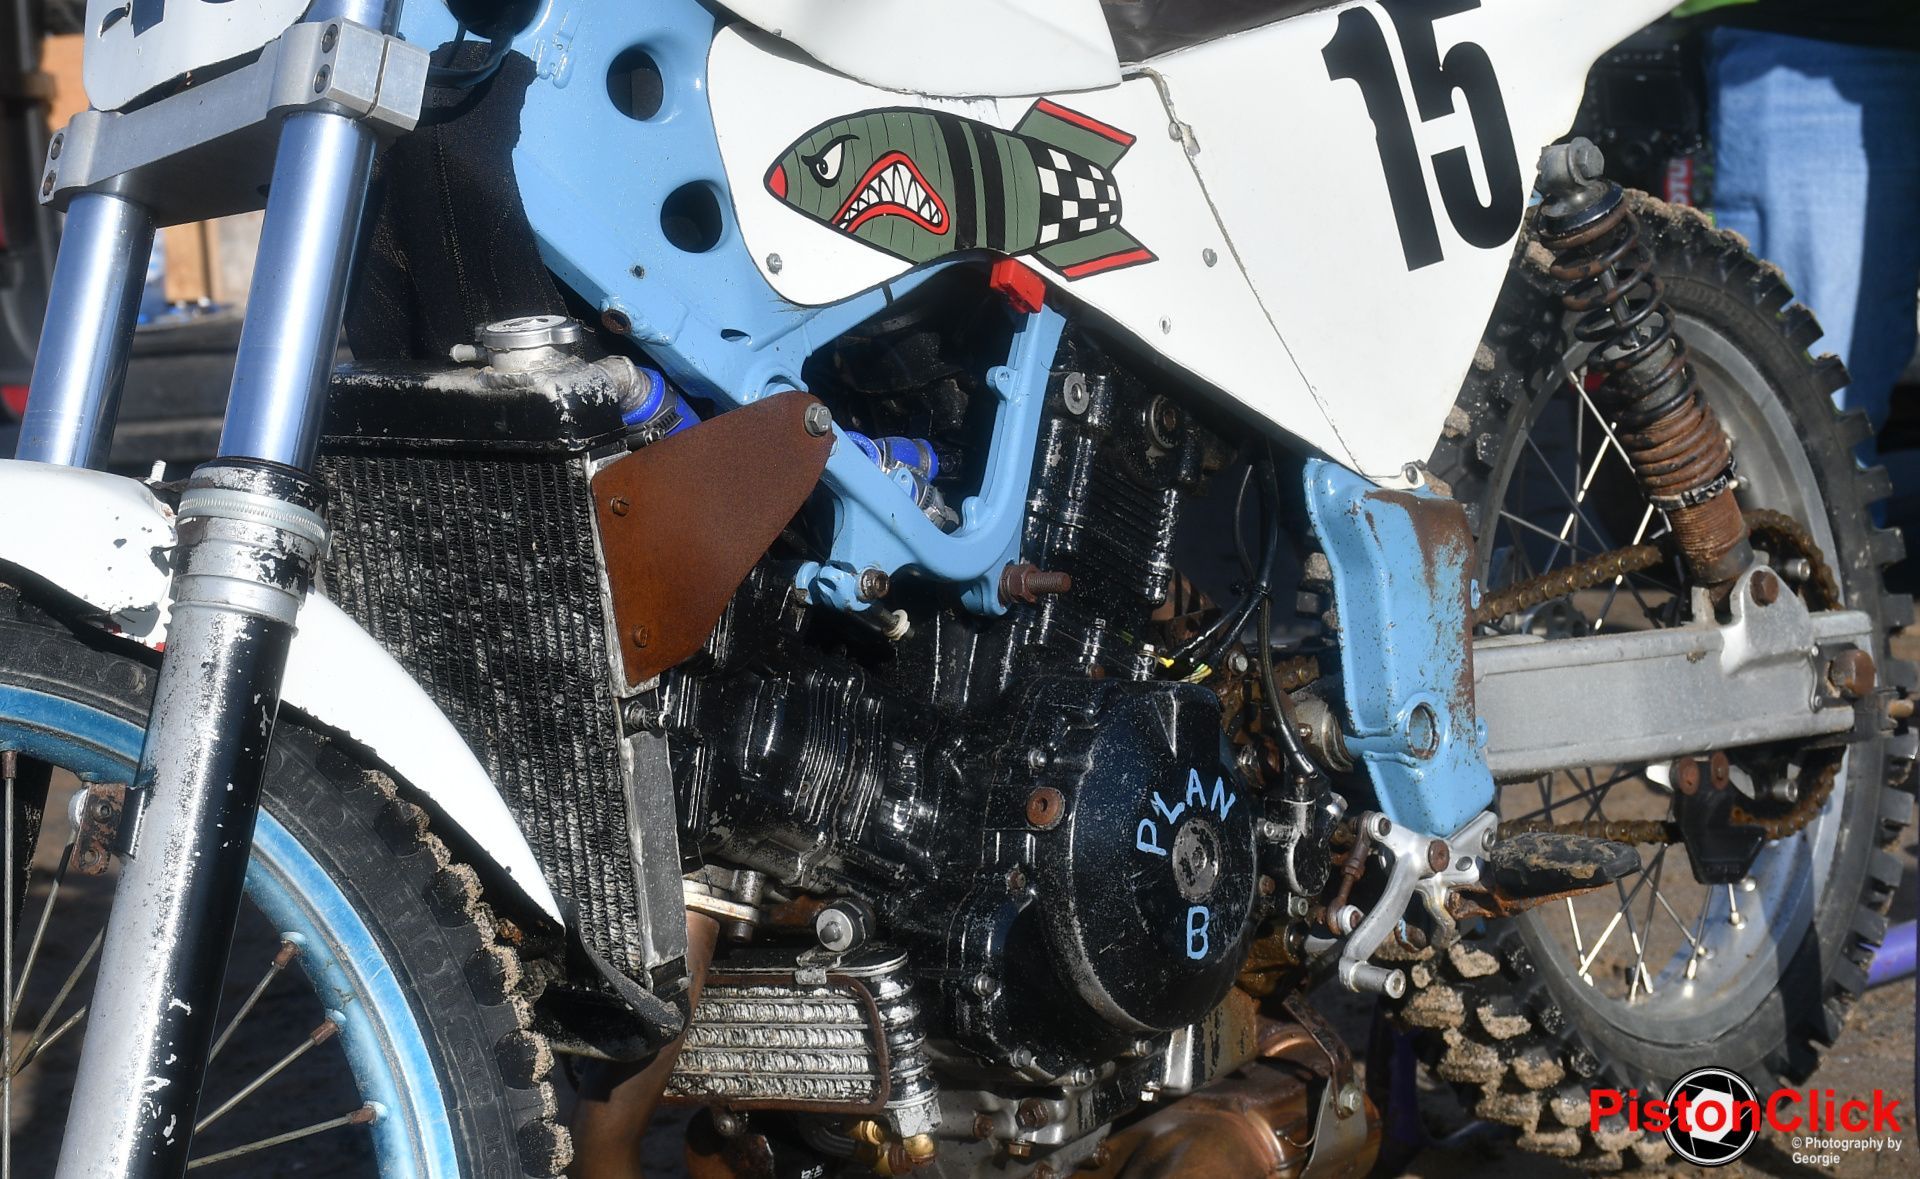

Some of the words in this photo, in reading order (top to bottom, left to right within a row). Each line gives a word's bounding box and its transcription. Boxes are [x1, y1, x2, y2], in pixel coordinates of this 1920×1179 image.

[1321, 0, 1524, 271] 15
[1669, 159, 1688, 206] OTU
[1136, 768, 1235, 856] PLAN
[1186, 905, 1209, 959] B
